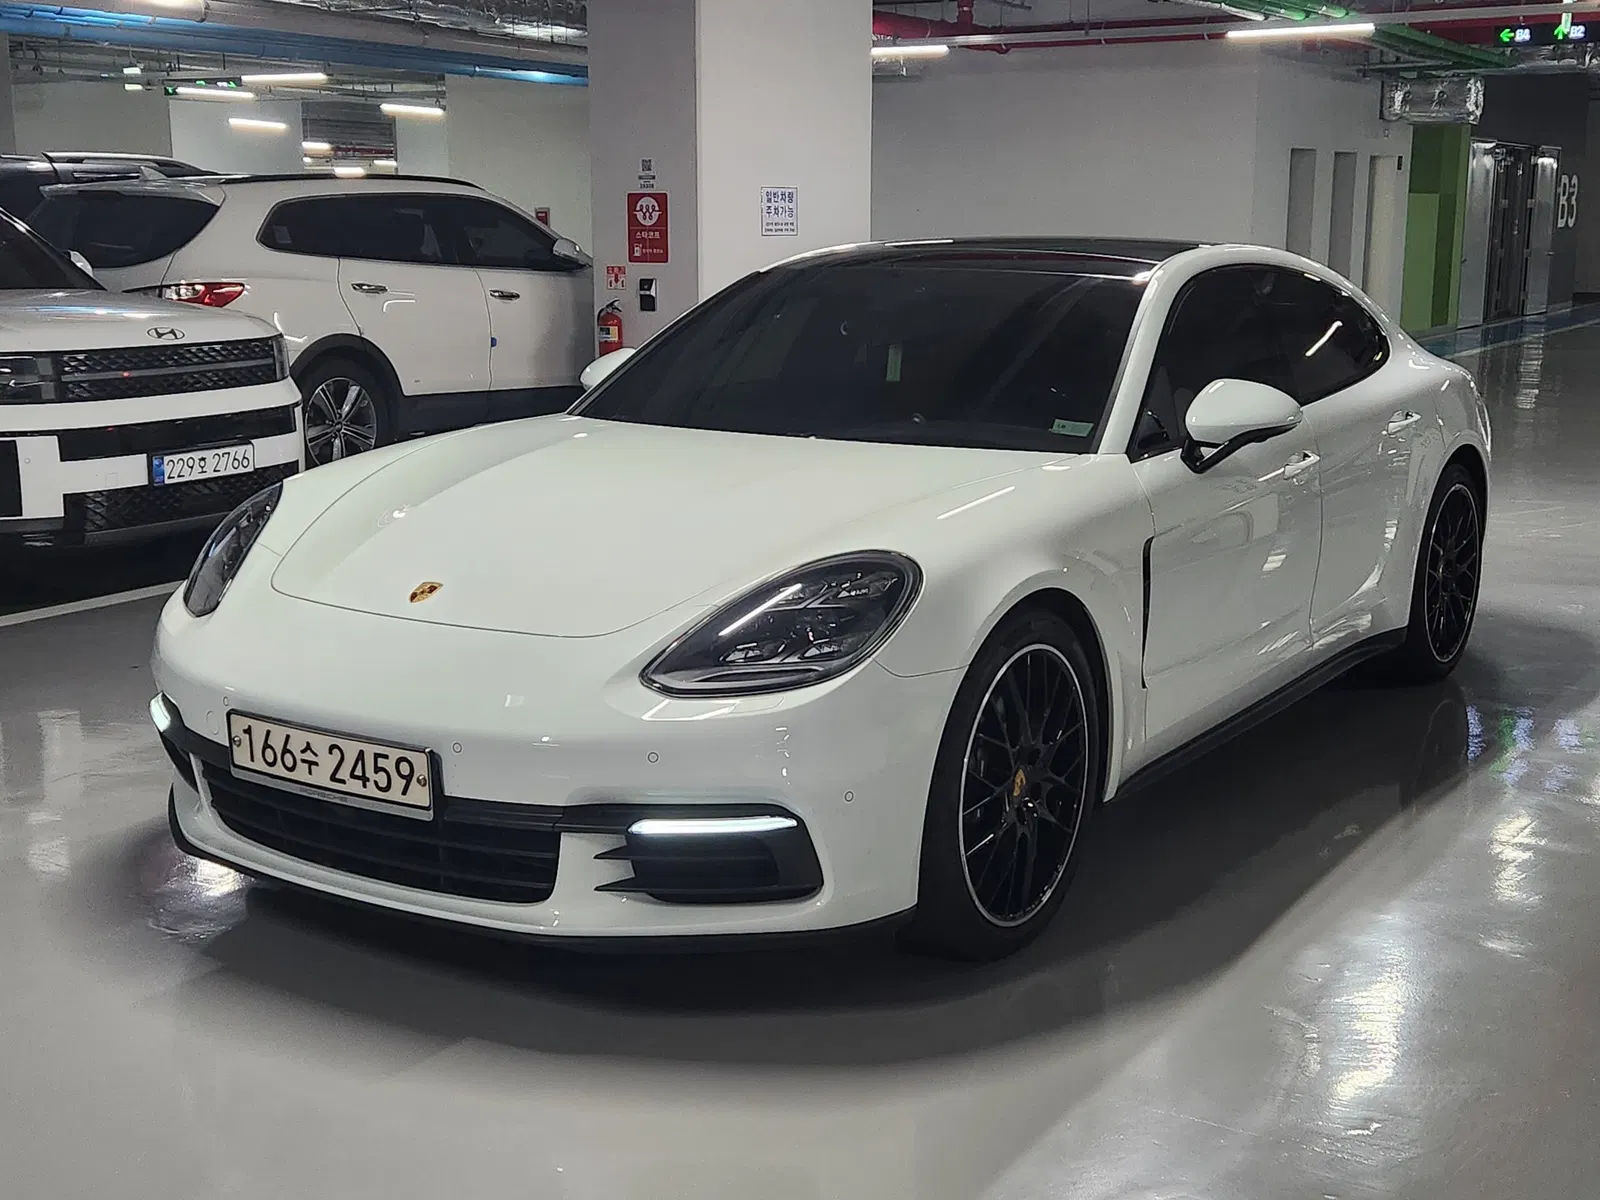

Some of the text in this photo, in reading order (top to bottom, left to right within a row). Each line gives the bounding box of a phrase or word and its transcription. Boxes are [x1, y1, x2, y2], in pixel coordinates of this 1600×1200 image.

[1514, 28, 1531, 42] B4
[1568, 25, 1586, 40] B2
[765, 190, 794, 204] 일반차량
[1557, 174, 1579, 228] B3
[765, 205, 794, 218] 주차가능
[635, 231, 660, 240] 스타코프
[166, 449, 250, 480] 229호 2766
[242, 725, 415, 796] 166수 2459
